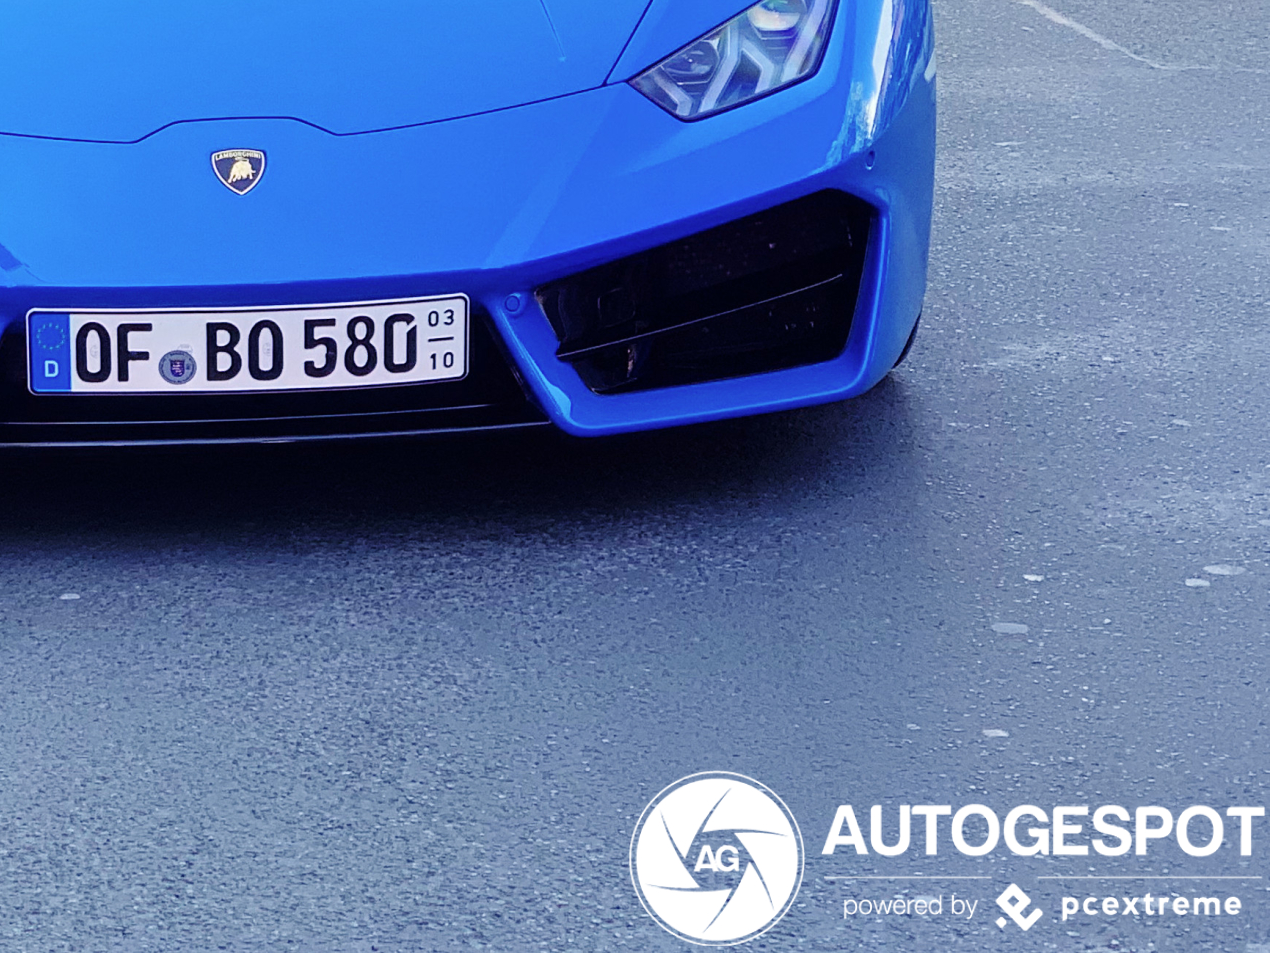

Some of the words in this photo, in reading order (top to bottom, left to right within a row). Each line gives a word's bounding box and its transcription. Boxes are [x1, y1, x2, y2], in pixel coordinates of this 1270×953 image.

[427, 309, 455, 327] 03
[75, 322, 152, 383] OF
[206, 319, 284, 381] BO
[303, 313, 417, 378] 580
[44, 360, 59, 377] D
[430, 351, 455, 370] 10
